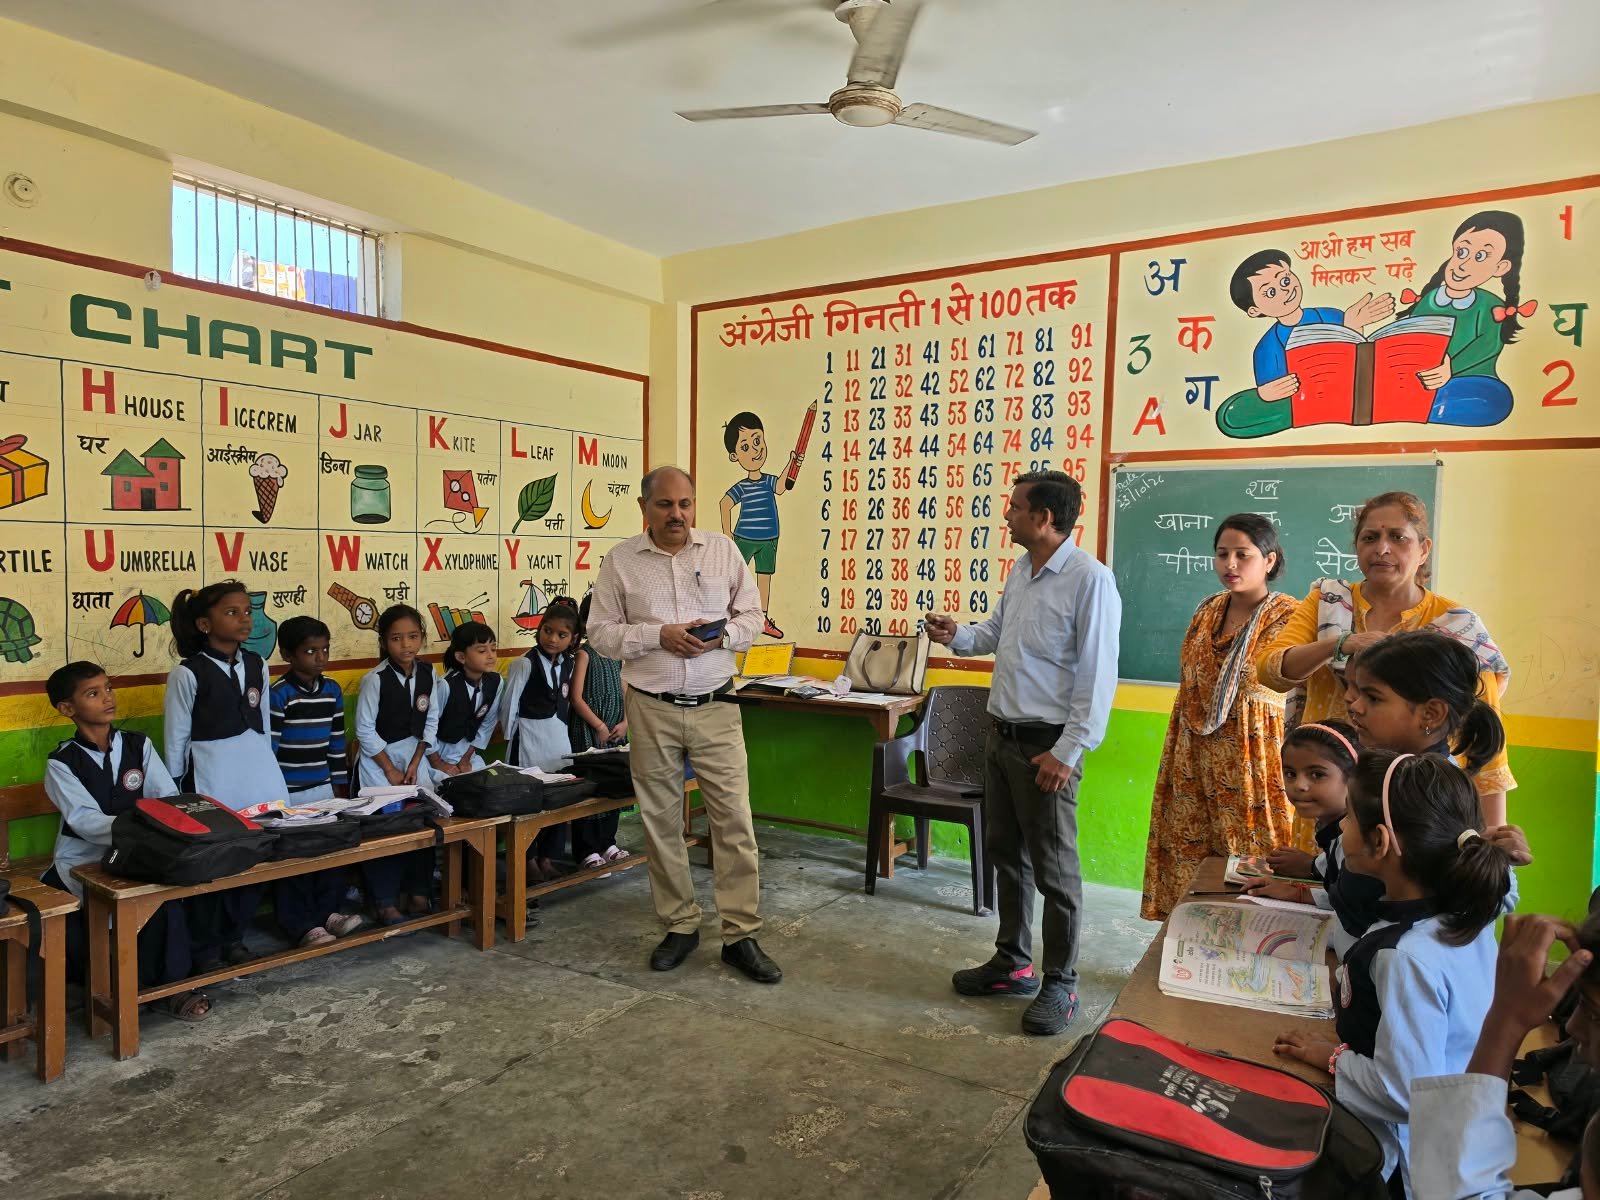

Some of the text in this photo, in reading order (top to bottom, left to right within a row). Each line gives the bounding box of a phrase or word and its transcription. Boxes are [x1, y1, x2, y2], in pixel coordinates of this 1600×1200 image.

[1559, 205, 1573, 241] 1
[1294, 230, 1416, 260] आओ हम सब
[1143, 257, 1186, 296] अ
[1311, 264, 1377, 288] मिलकर
[719, 279, 1078, 348] अंग्रेजी गिनती 1 से 100 तक
[1549, 303, 1588, 347] घ
[70, 293, 373, 380] CHART
[826, 322, 1093, 375] 1 11 21 31 41 51 61 71 81 91
[1177, 315, 1216, 353] क
[1126, 333, 1152, 376] 3
[82, 367, 186, 422] H HOUSE
[823, 356, 1094, 404] 2 12 22 32 42 52 62 72 82 92
[1185, 375, 1219, 411] ग
[1541, 359, 1578, 408] 2
[219, 386, 297, 434] I ICECREM
[328, 402, 382, 443] J JAR
[821, 390, 1092, 434] 3 13 23 33 43 53 63 73 83 93
[1132, 396, 1167, 436] A
[77, 435, 110, 454] घर
[428, 415, 476, 453] K KITE
[511, 426, 555, 462] L LEAF
[821, 423, 1095, 463] 4 14 24 34 44 54 64 74 84 94
[578, 436, 628, 470] M MOON
[476, 472, 498, 487] पतंग
[823, 469, 833, 493] 5
[842, 468, 860, 493] 15
[867, 467, 887, 492] 25
[892, 466, 912, 490] 35
[917, 465, 938, 489] 45
[946, 464, 965, 489] 55
[972, 462, 994, 487] 65
[1001, 461, 1021, 486] 75
[1063, 457, 1087, 483] 95
[544, 512, 565, 531] पत्ती
[821, 498, 832, 522] 6
[842, 498, 858, 521] 16
[867, 496, 885, 521] 26
[891, 496, 911, 520] 36
[917, 495, 938, 520] 46
[945, 495, 965, 519] 56
[971, 494, 992, 519] 66
[1154, 513, 1214, 531] खाना
[1328, 504, 1366, 523] आ
[84, 528, 197, 573] U UMBRELLA
[214, 531, 289, 573] V VASE
[325, 534, 409, 572] W WATCH
[422, 537, 498, 572] X XYLOPHONE
[504, 538, 563, 571] Y YACHT
[575, 540, 591, 571] Z
[820, 528, 831, 551] 7
[840, 528, 858, 552] 17
[865, 527, 885, 551] 27
[891, 527, 911, 551] 37
[916, 527, 937, 550] 47
[944, 526, 963, 551] 57
[970, 525, 990, 550] 67
[998, 526, 1014, 549] 7
[820, 557, 829, 580] 8
[840, 557, 857, 581] 18
[866, 557, 884, 581] 28
[890, 557, 909, 582] 38
[916, 557, 936, 582] 48
[944, 557, 962, 583] 58
[969, 558, 989, 583] 68
[1157, 546, 1216, 574] पीला
[71, 591, 114, 612] छाता
[272, 584, 307, 608] सुराही
[820, 586, 988, 613] 9 19 29 39 49 59 69
[817, 615, 832, 634] 10
[839, 615, 857, 635] 20
[864, 617, 882, 635] 30
[888, 618, 909, 636] 40
